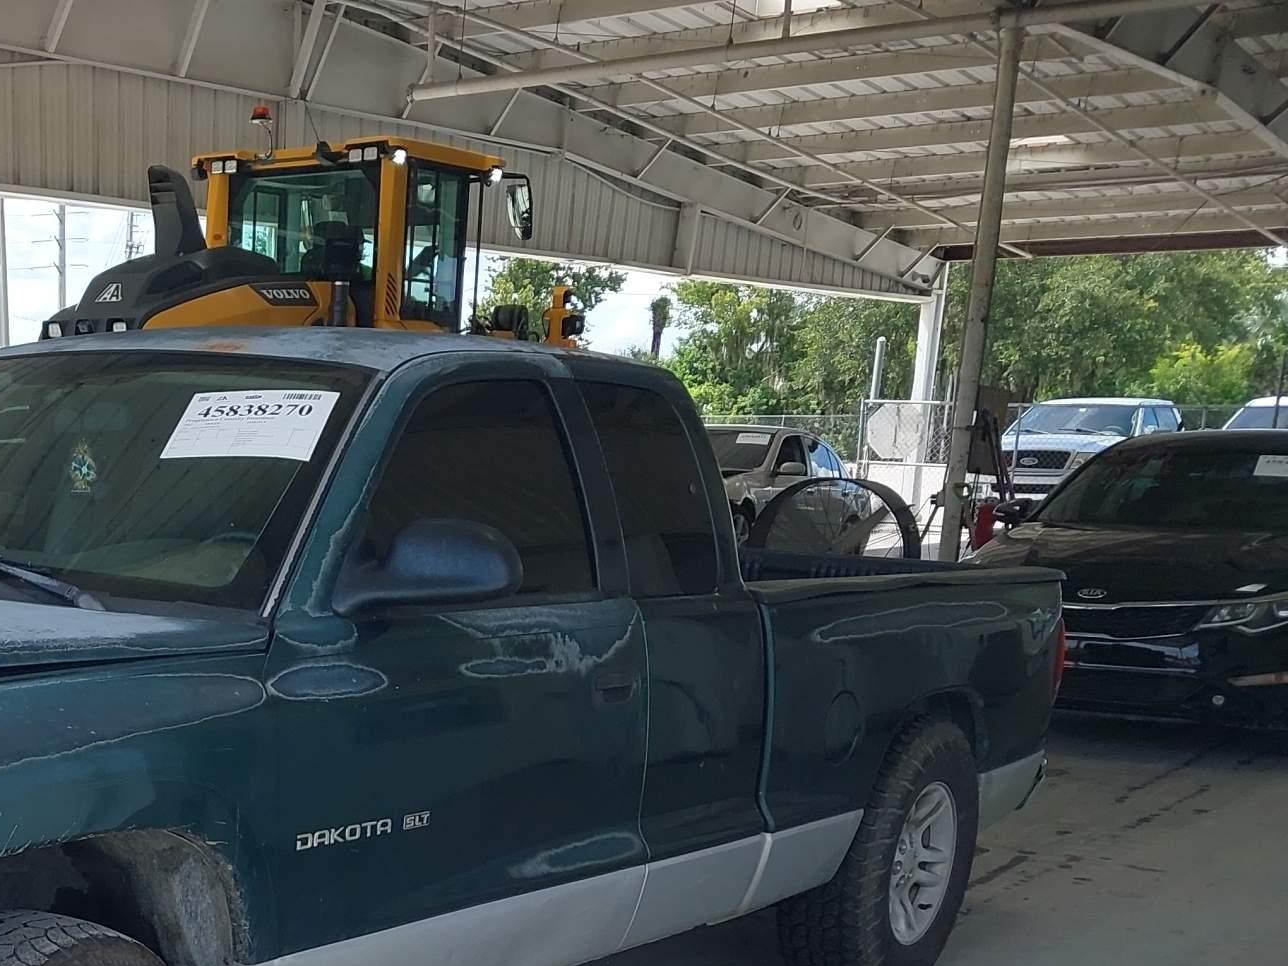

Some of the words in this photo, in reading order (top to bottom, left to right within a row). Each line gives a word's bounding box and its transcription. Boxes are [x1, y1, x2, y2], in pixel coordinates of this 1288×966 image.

[261, 288, 310, 300] VOLVO
[197, 404, 313, 418] 45838270
[296, 818, 392, 851] DAKOTA
[405, 813, 430, 829] SLT
